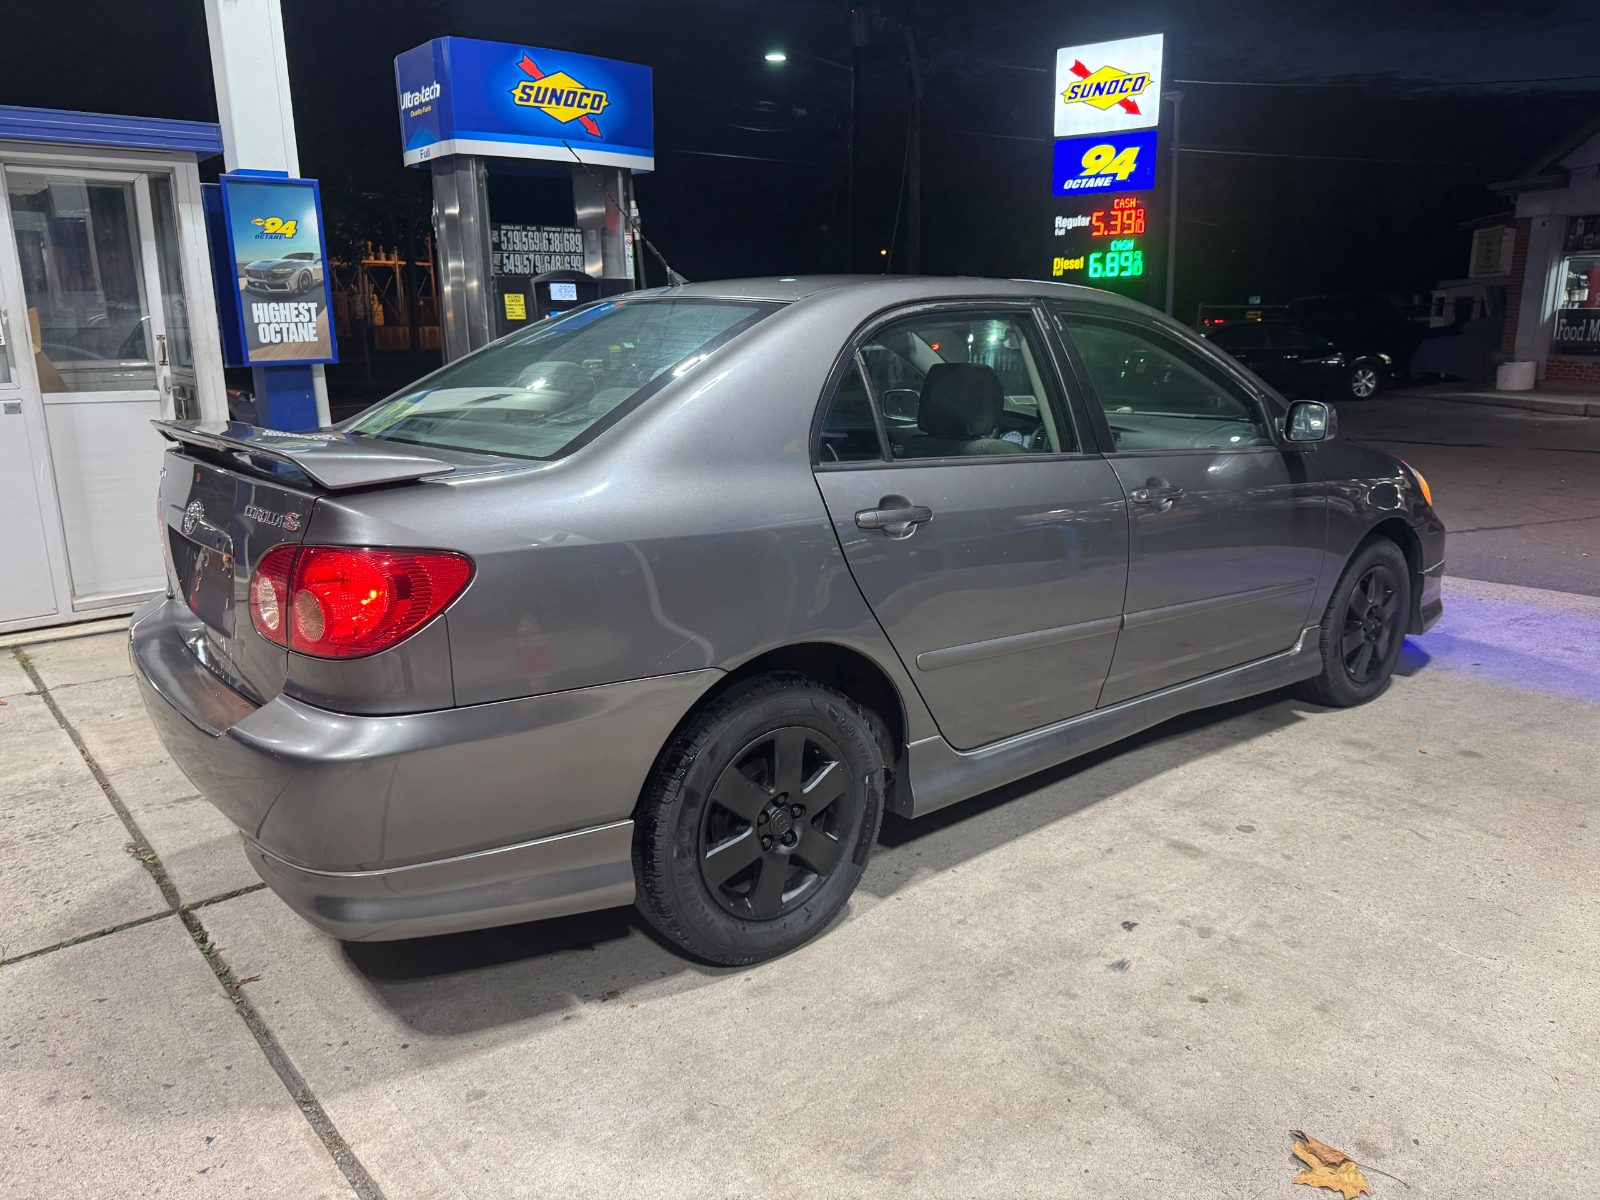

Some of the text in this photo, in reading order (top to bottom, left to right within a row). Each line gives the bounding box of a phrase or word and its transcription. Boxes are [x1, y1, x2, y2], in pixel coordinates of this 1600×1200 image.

[518, 85, 605, 111] SUNOCO
[1068, 76, 1146, 100] SUNOCO
[1080, 145, 1139, 180] 94
[1063, 177, 1112, 190] OCTANE
[1114, 197, 1137, 209] CASH
[261, 216, 297, 239] 94
[1055, 214, 1091, 229] Regular
[254, 233, 285, 241] OCTANE
[1111, 239, 1135, 252] CASH
[1053, 256, 1085, 270] Diesel
[252, 302, 318, 324] HIGHEST
[258, 322, 318, 344] OCTANE
[1555, 319, 1584, 341] Food
[245, 505, 301, 531] COROLLA S
